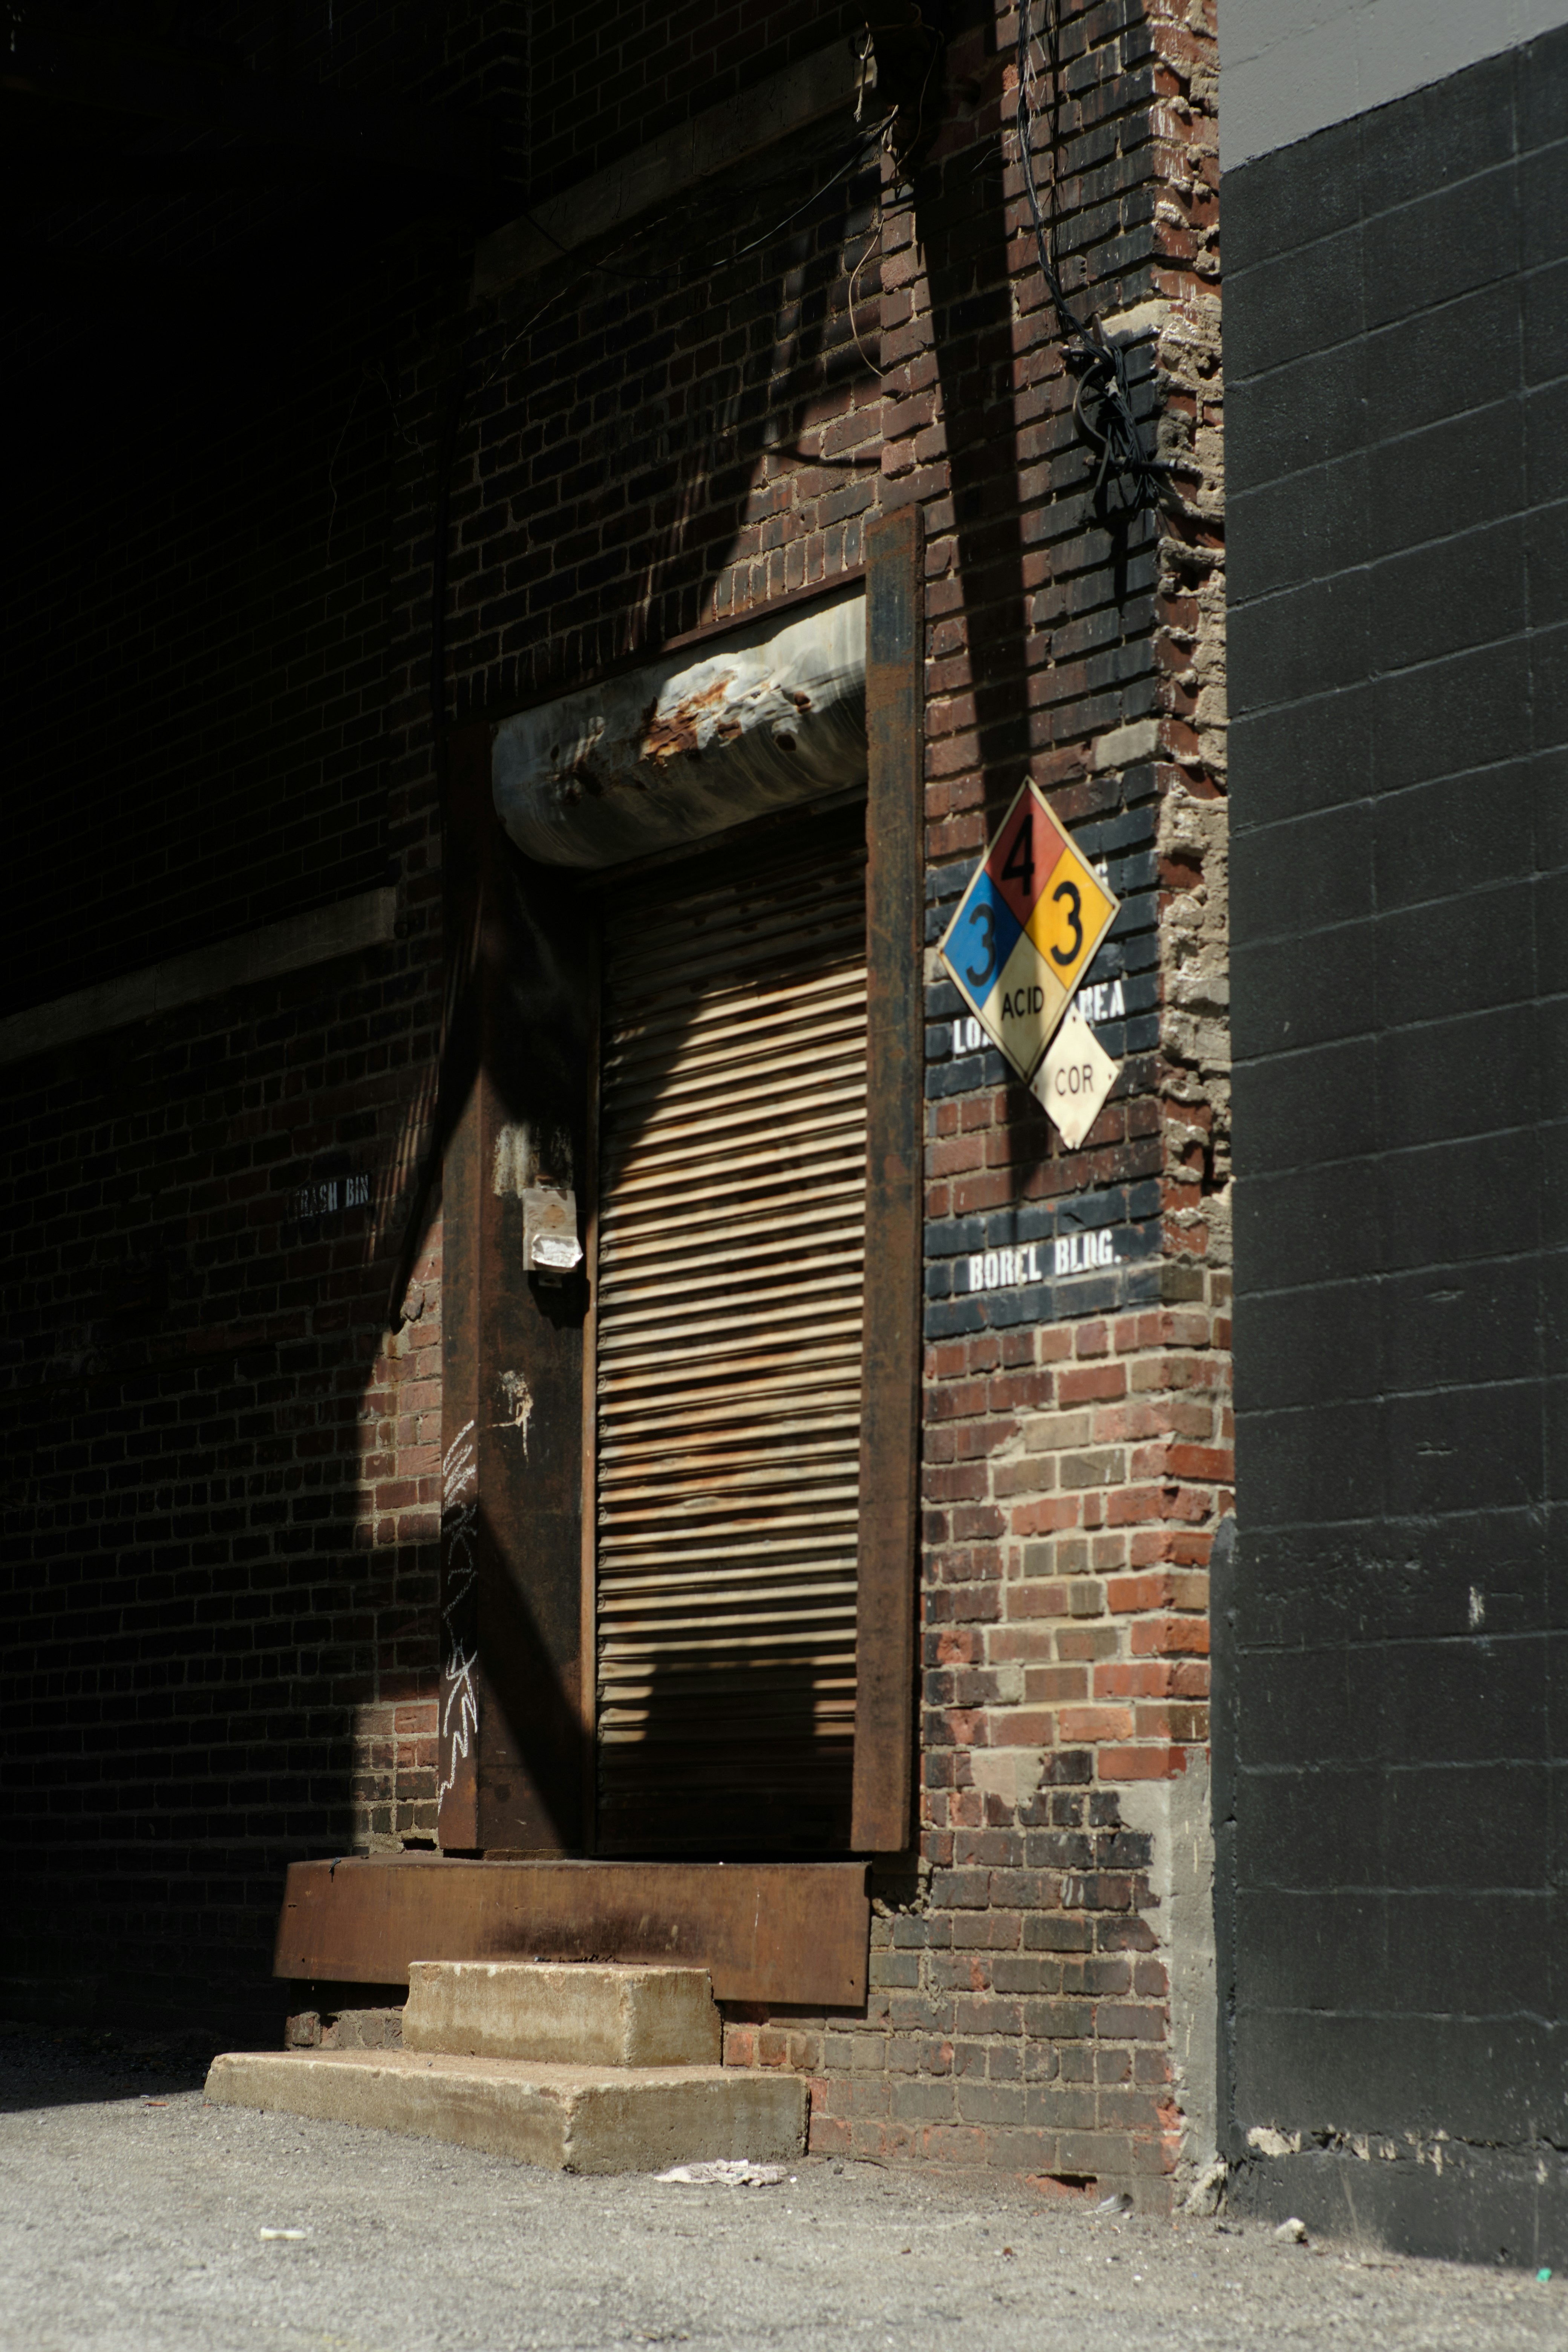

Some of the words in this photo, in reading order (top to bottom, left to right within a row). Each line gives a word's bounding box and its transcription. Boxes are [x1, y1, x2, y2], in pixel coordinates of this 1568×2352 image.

[1001, 814, 1035, 896] 4
[966, 903, 996, 987] 3
[1050, 880, 1083, 965] 3
[1001, 986, 1044, 1020] ACID
[1056, 1064, 1093, 1096] COR
[346, 1174, 369, 1207] BIN
[969, 1246, 1042, 1291] BOREL
